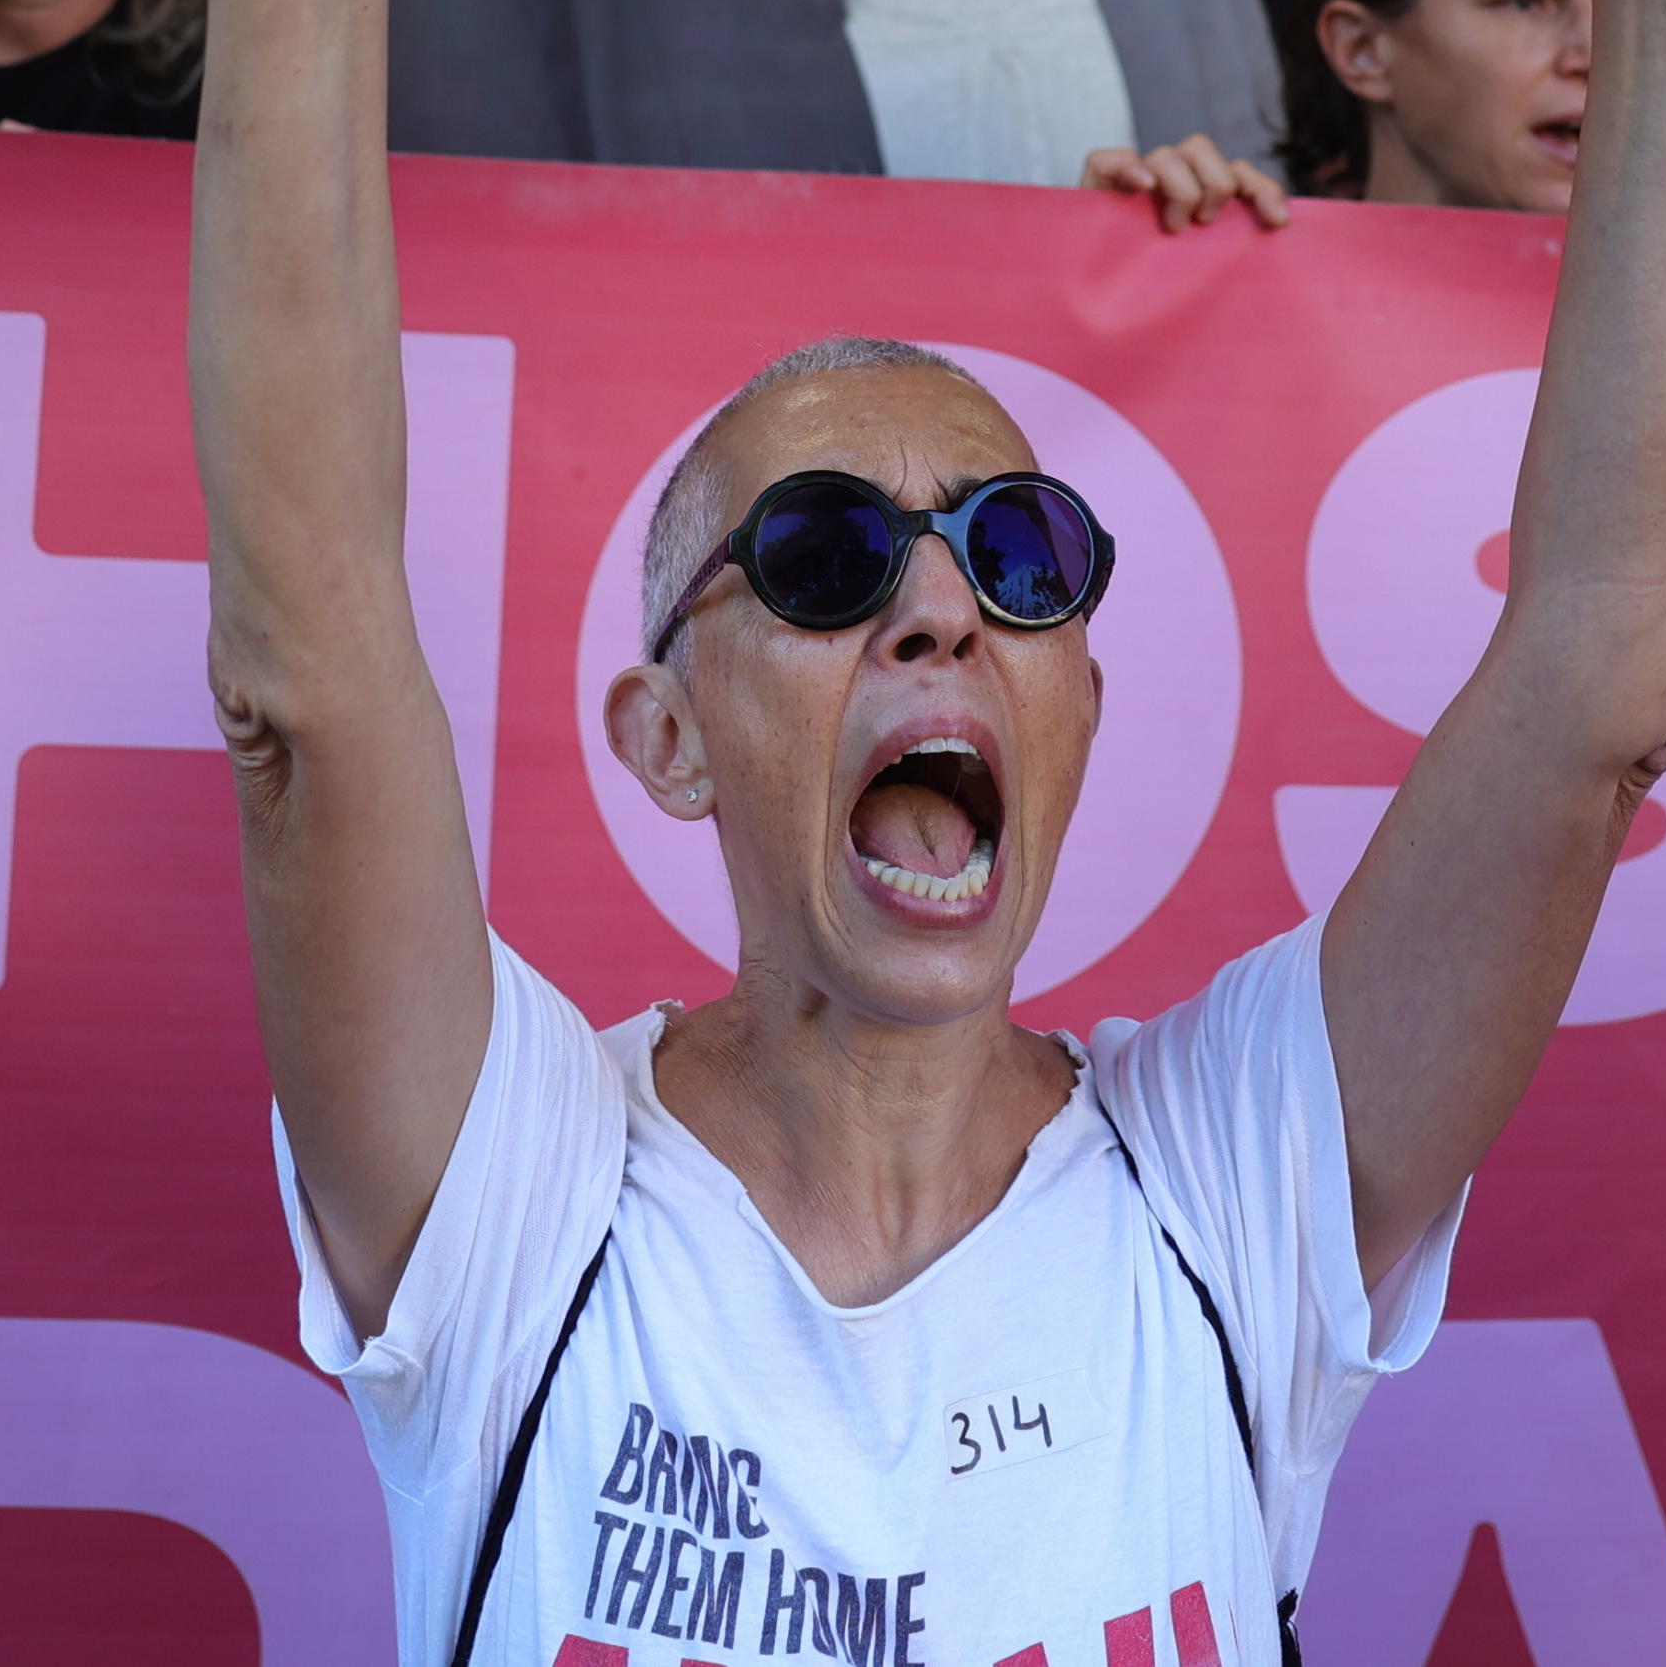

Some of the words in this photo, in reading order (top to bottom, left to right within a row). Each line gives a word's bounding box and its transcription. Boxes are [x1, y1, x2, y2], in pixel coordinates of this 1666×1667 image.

[598, 1401, 771, 1540] BRING
[949, 1394, 1053, 1476] 314
[583, 1510, 745, 1651] THEM
[759, 1547, 927, 1667] HOME
